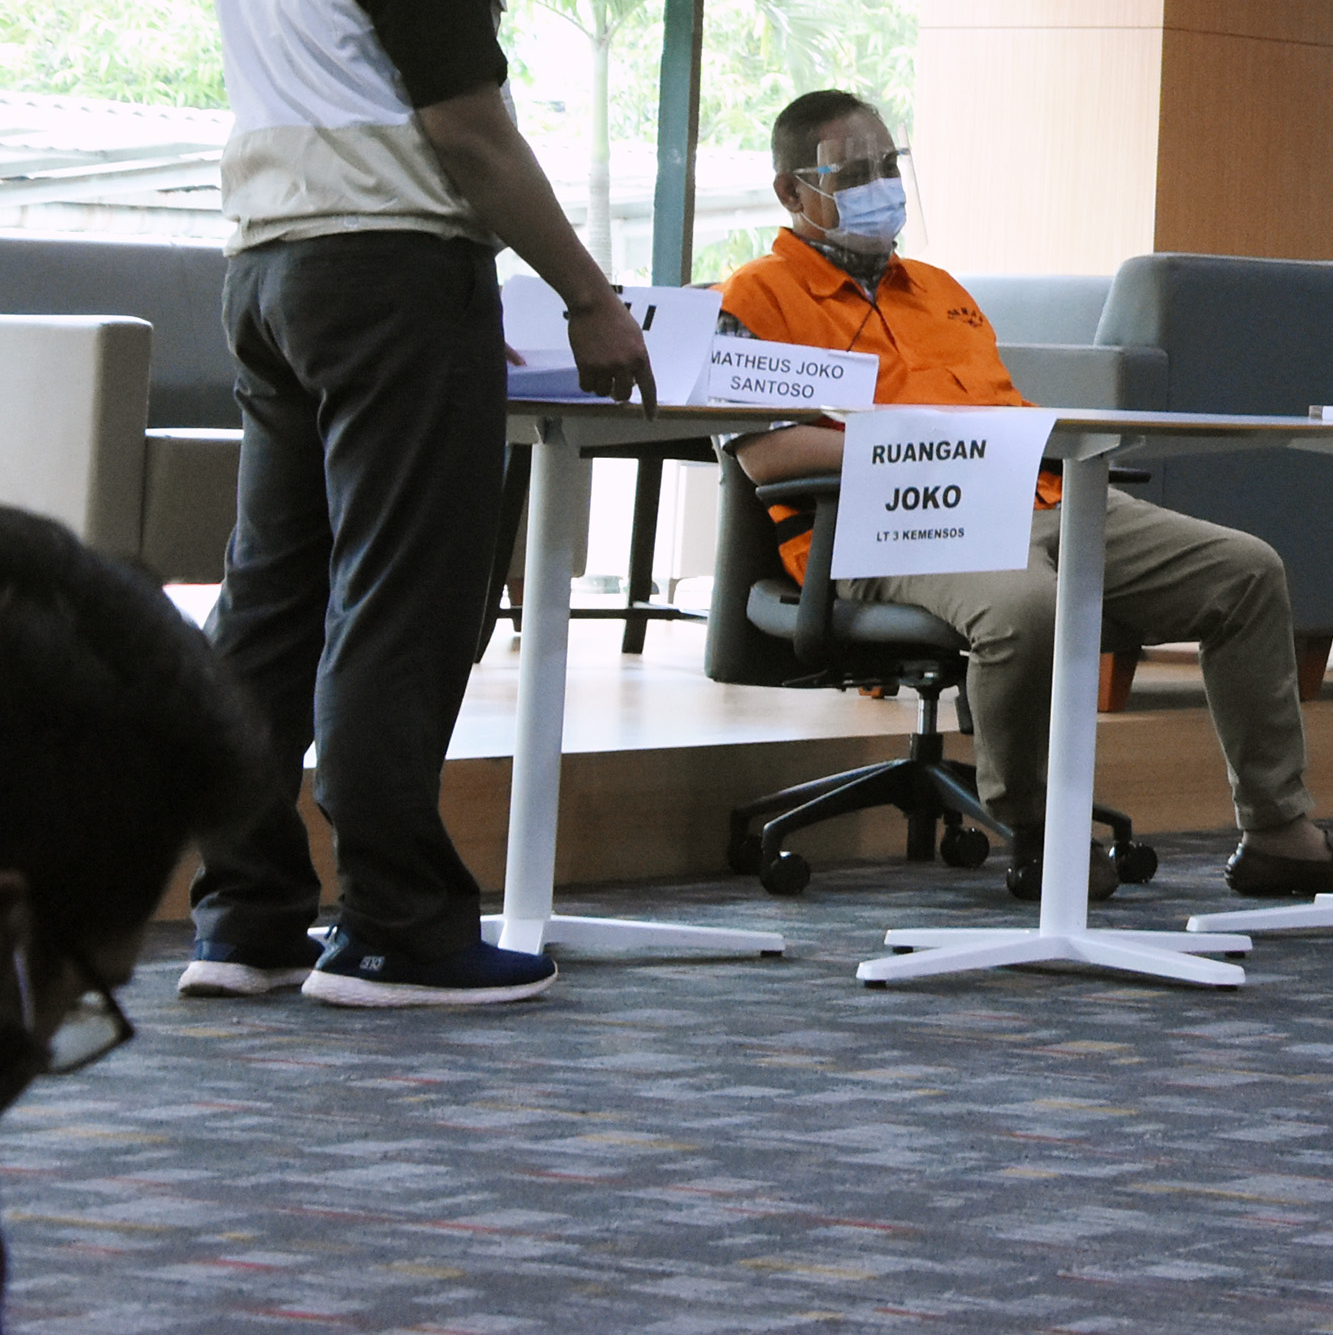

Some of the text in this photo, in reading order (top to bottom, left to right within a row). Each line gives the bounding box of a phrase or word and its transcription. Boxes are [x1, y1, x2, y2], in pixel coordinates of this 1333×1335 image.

[711, 351, 845, 380] MATHEUS JOKO
[730, 375, 815, 399] SANTOSO
[871, 439, 987, 465] RUANGAN
[884, 484, 962, 512] JOKO
[876, 527, 965, 542] LT 3 KEMENSOS
